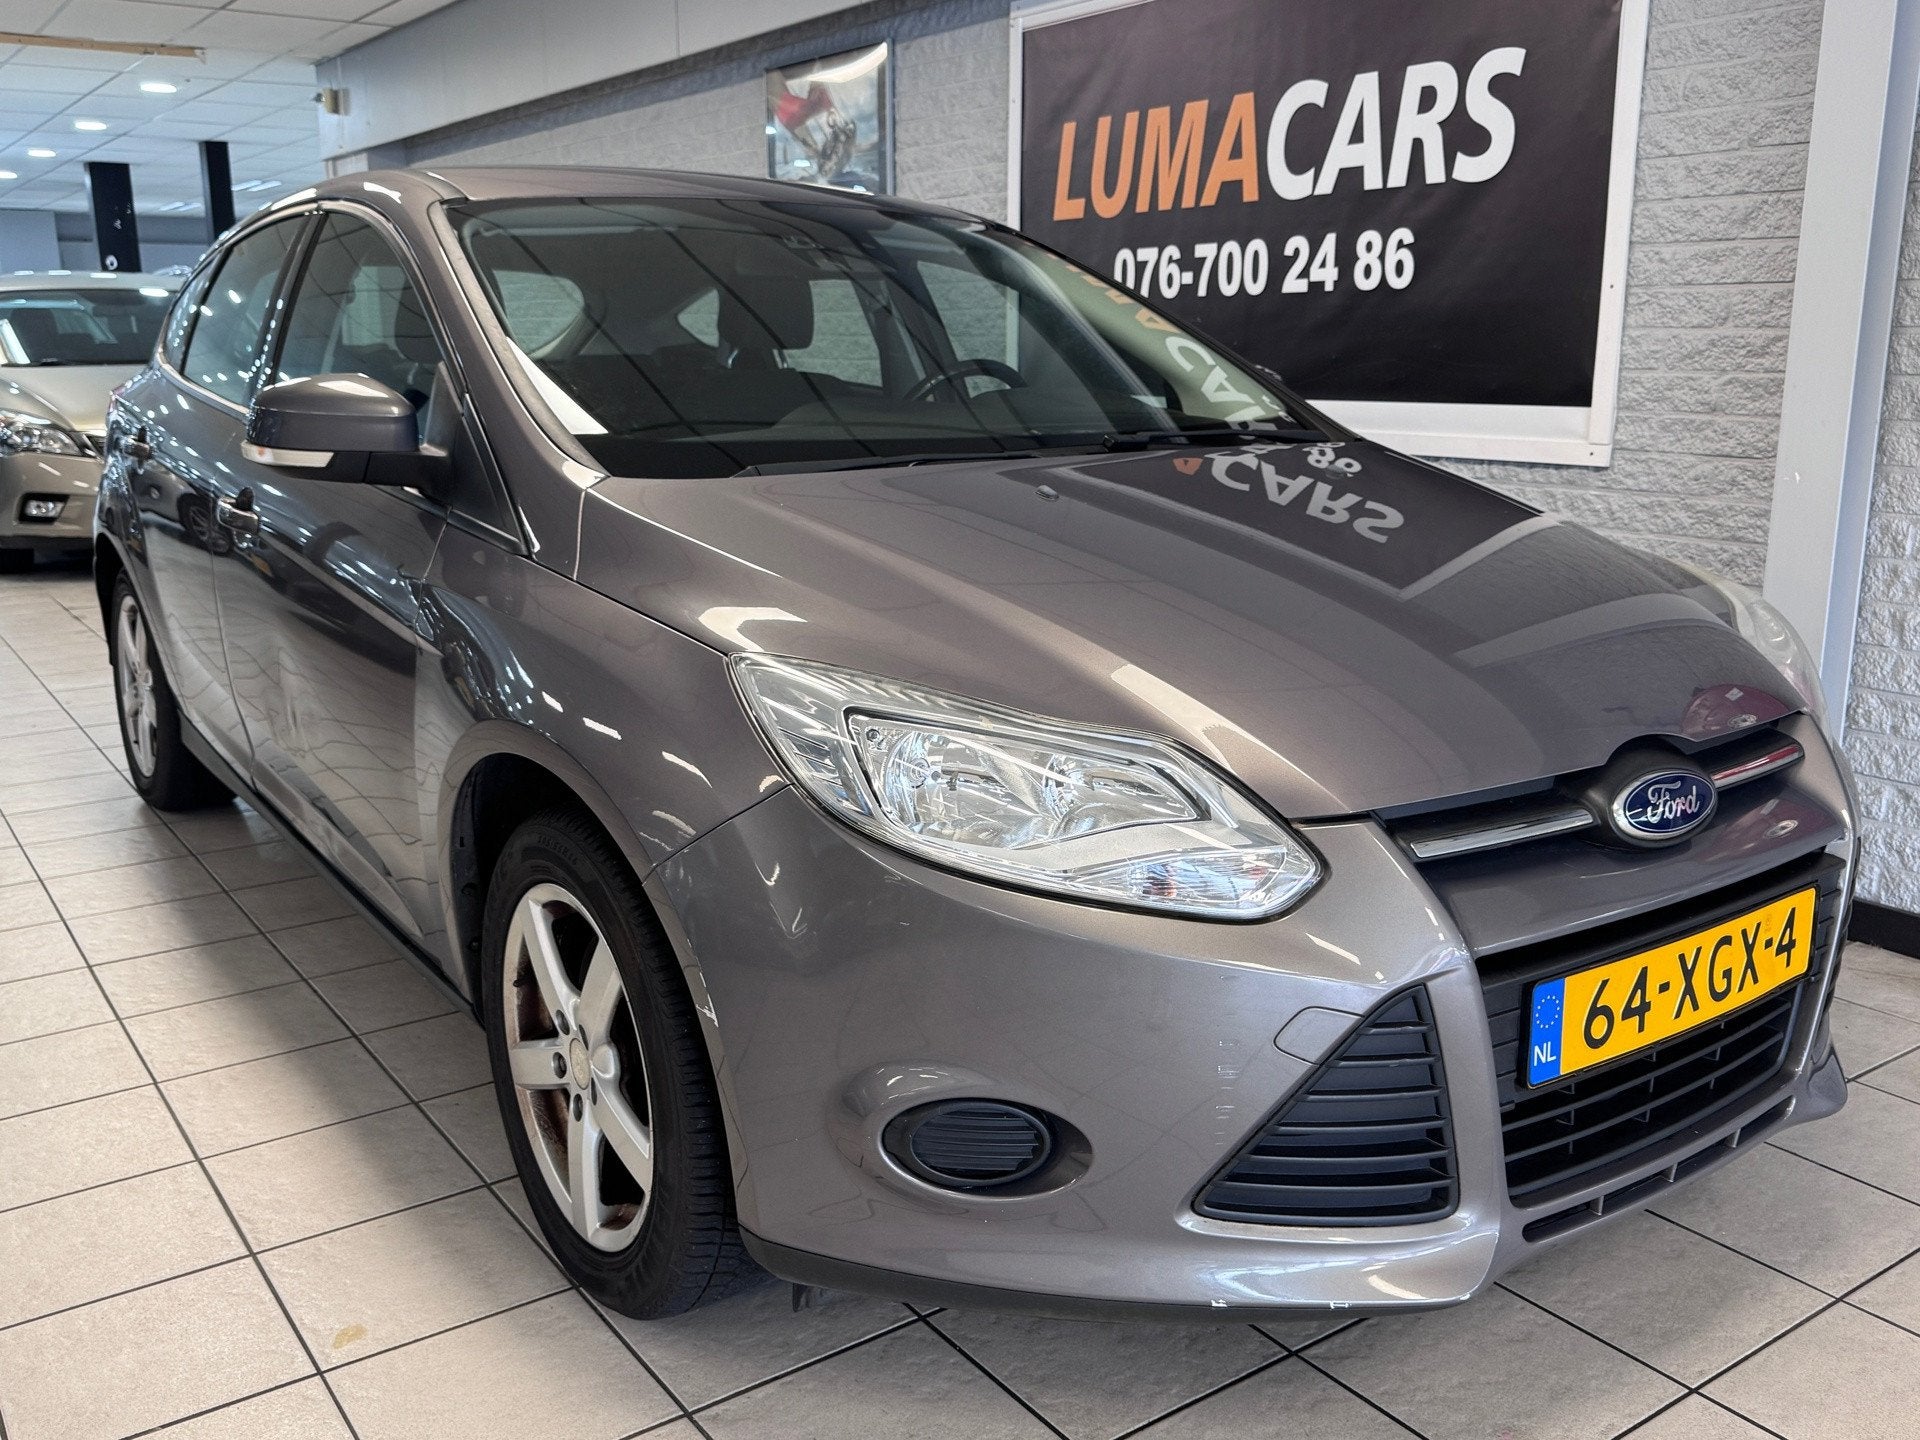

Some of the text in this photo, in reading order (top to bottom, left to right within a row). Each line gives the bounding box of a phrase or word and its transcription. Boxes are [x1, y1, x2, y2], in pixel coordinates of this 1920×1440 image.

[1053, 46, 1527, 221] LUMACARS
[1113, 227, 1415, 299] 076-700 24 86
[1646, 780, 1700, 824] Ford
[1583, 906, 1797, 1050] 64-XGX-4
[1533, 1041, 1557, 1067] NL
